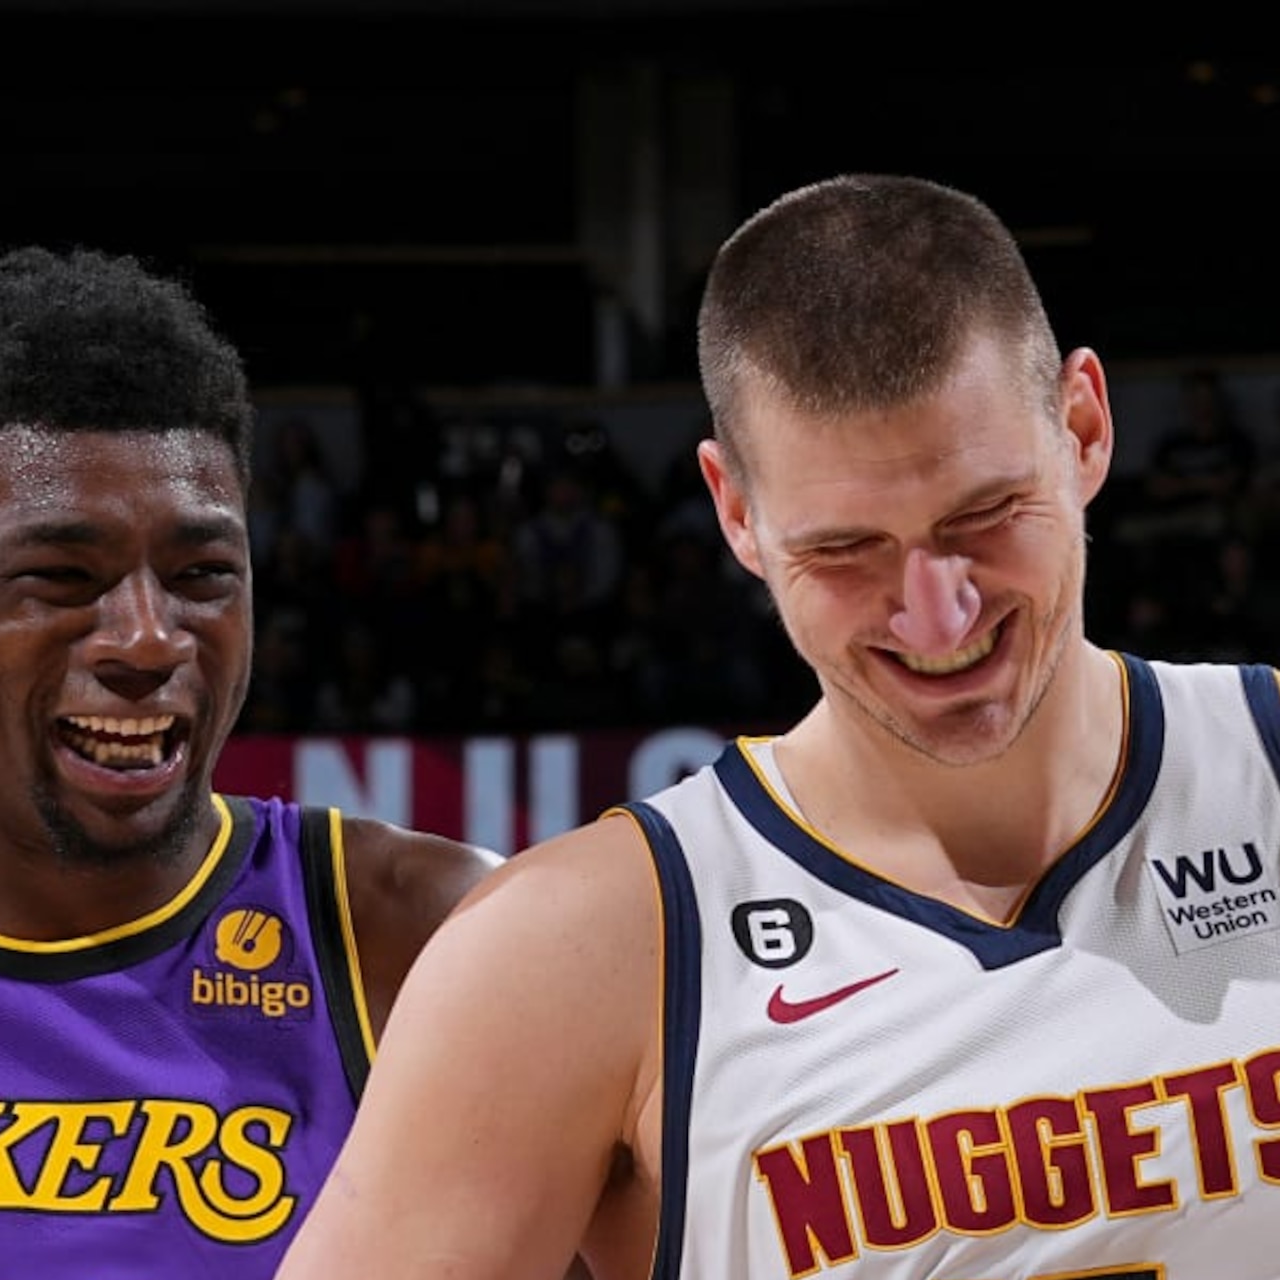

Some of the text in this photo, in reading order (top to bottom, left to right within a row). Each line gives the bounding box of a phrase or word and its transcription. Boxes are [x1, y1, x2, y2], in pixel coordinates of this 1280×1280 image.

[1152, 843, 1263, 899] WU
[1167, 889, 1276, 926] Western
[1193, 911, 1268, 940] Union
[747, 908, 796, 961] 6
[192, 968, 310, 1017] bibigo
